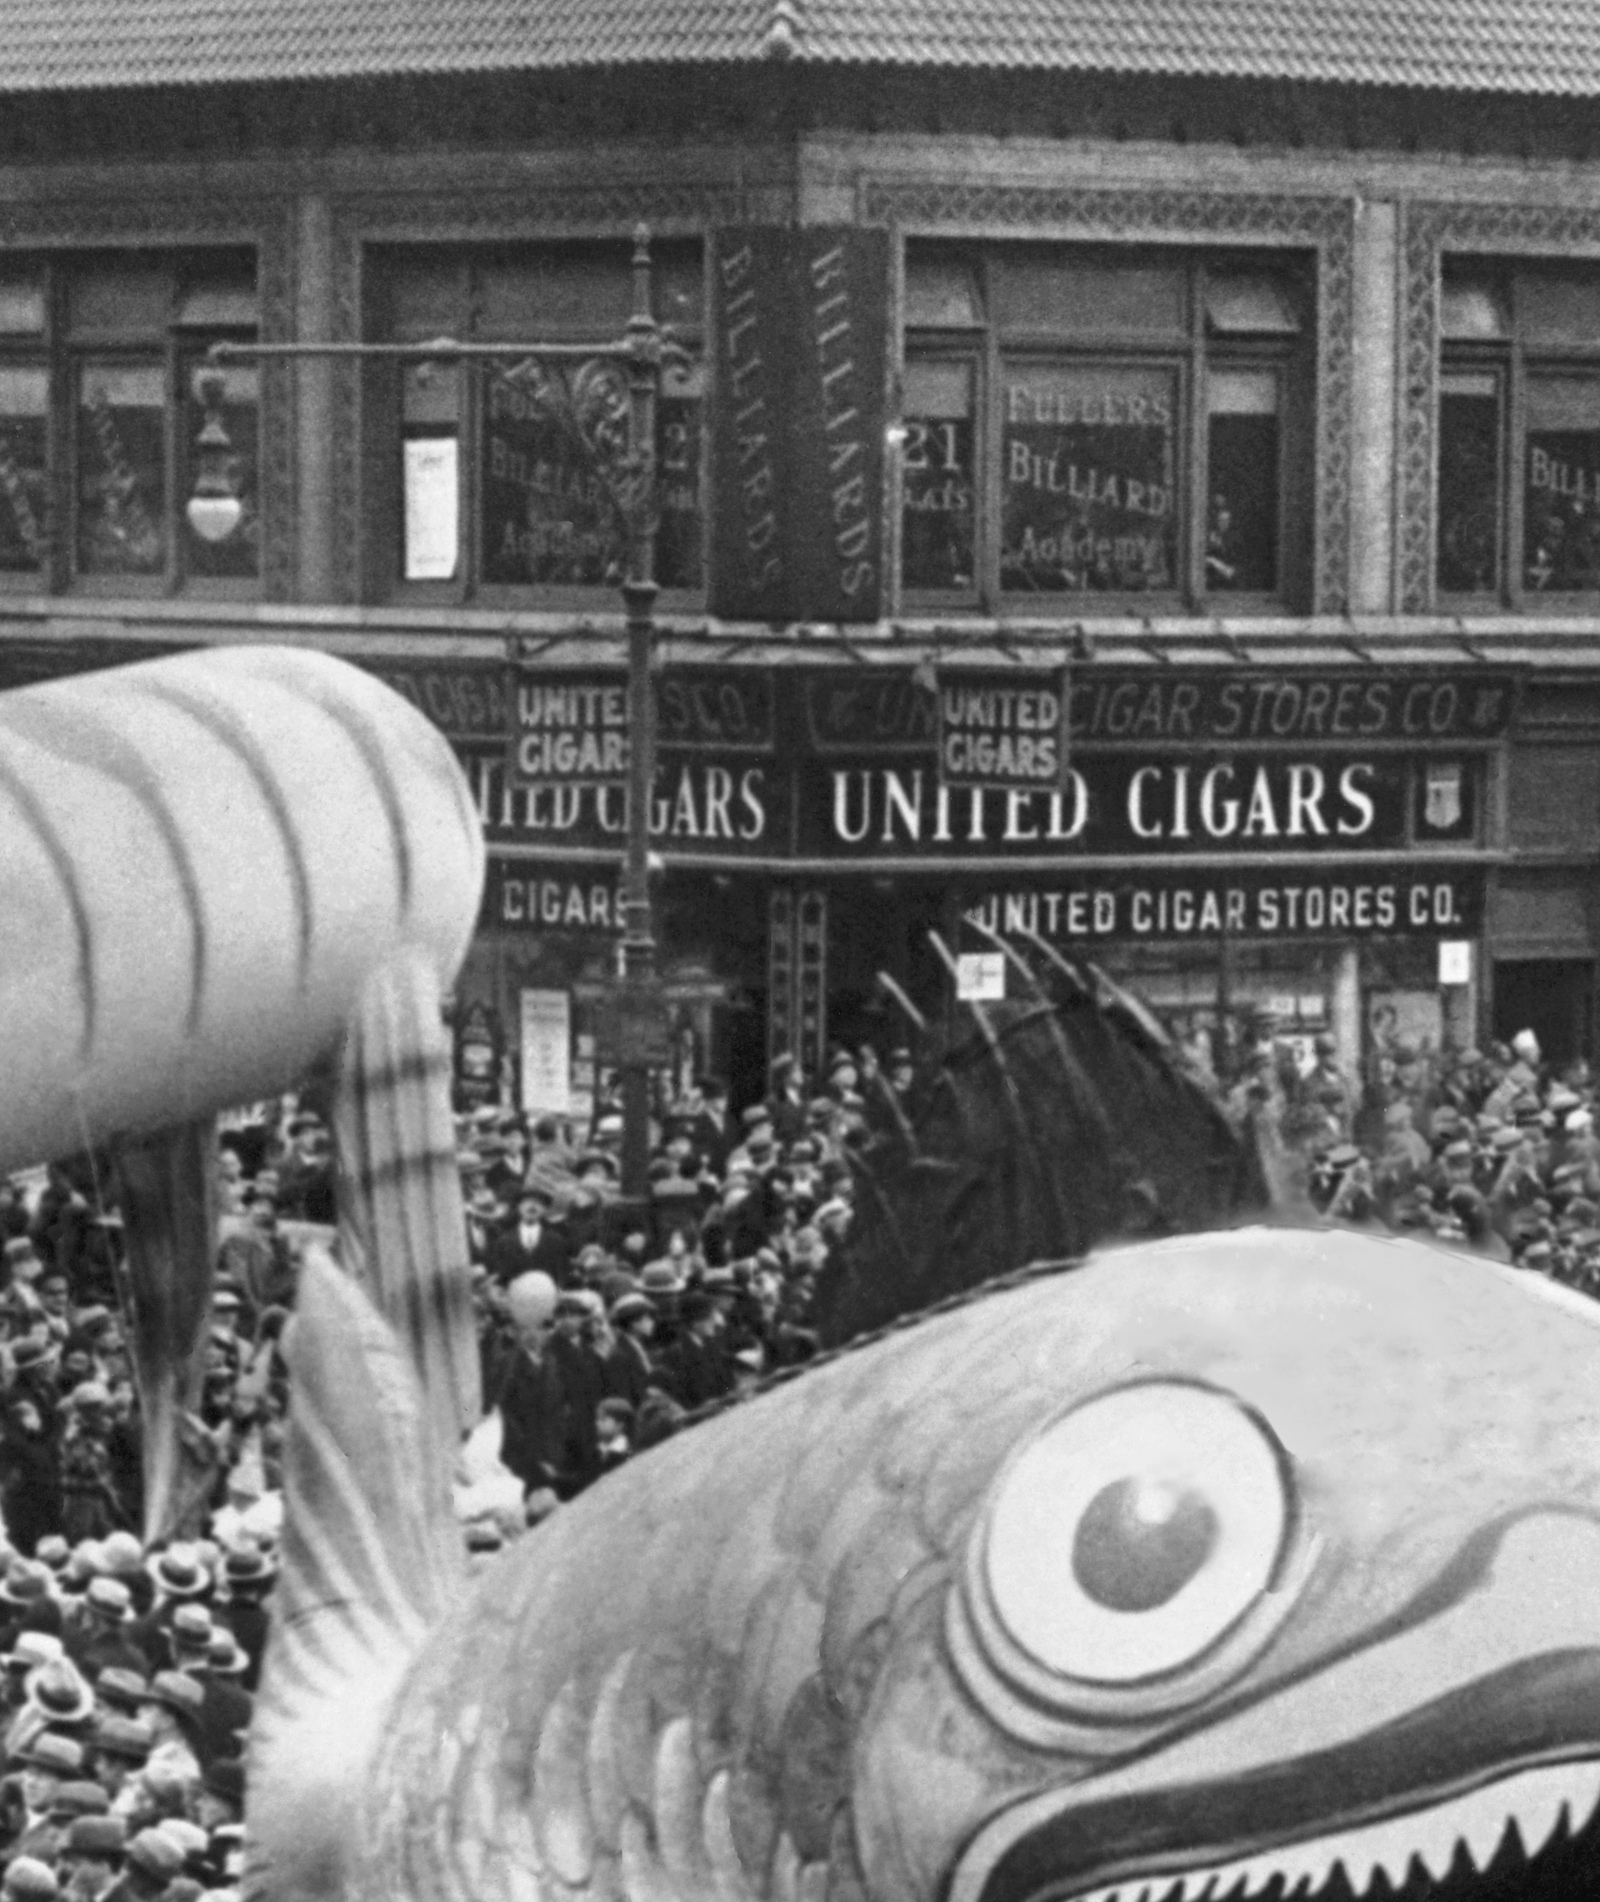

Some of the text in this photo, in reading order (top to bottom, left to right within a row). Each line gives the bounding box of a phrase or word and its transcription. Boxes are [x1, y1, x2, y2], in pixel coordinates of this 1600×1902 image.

[811, 246, 876, 596] BILLIARDS
[518, 687, 627, 727] UNITE
[946, 689, 1059, 730] UNITED
[1215, 683, 1390, 734] STORES
[518, 732, 632, 774] CIGAR
[945, 734, 1057, 777] CIGARS
[832, 763, 1375, 842] UNITED CIGARS
[975, 885, 1461, 933] UNITED CIGAR STORES CO.
